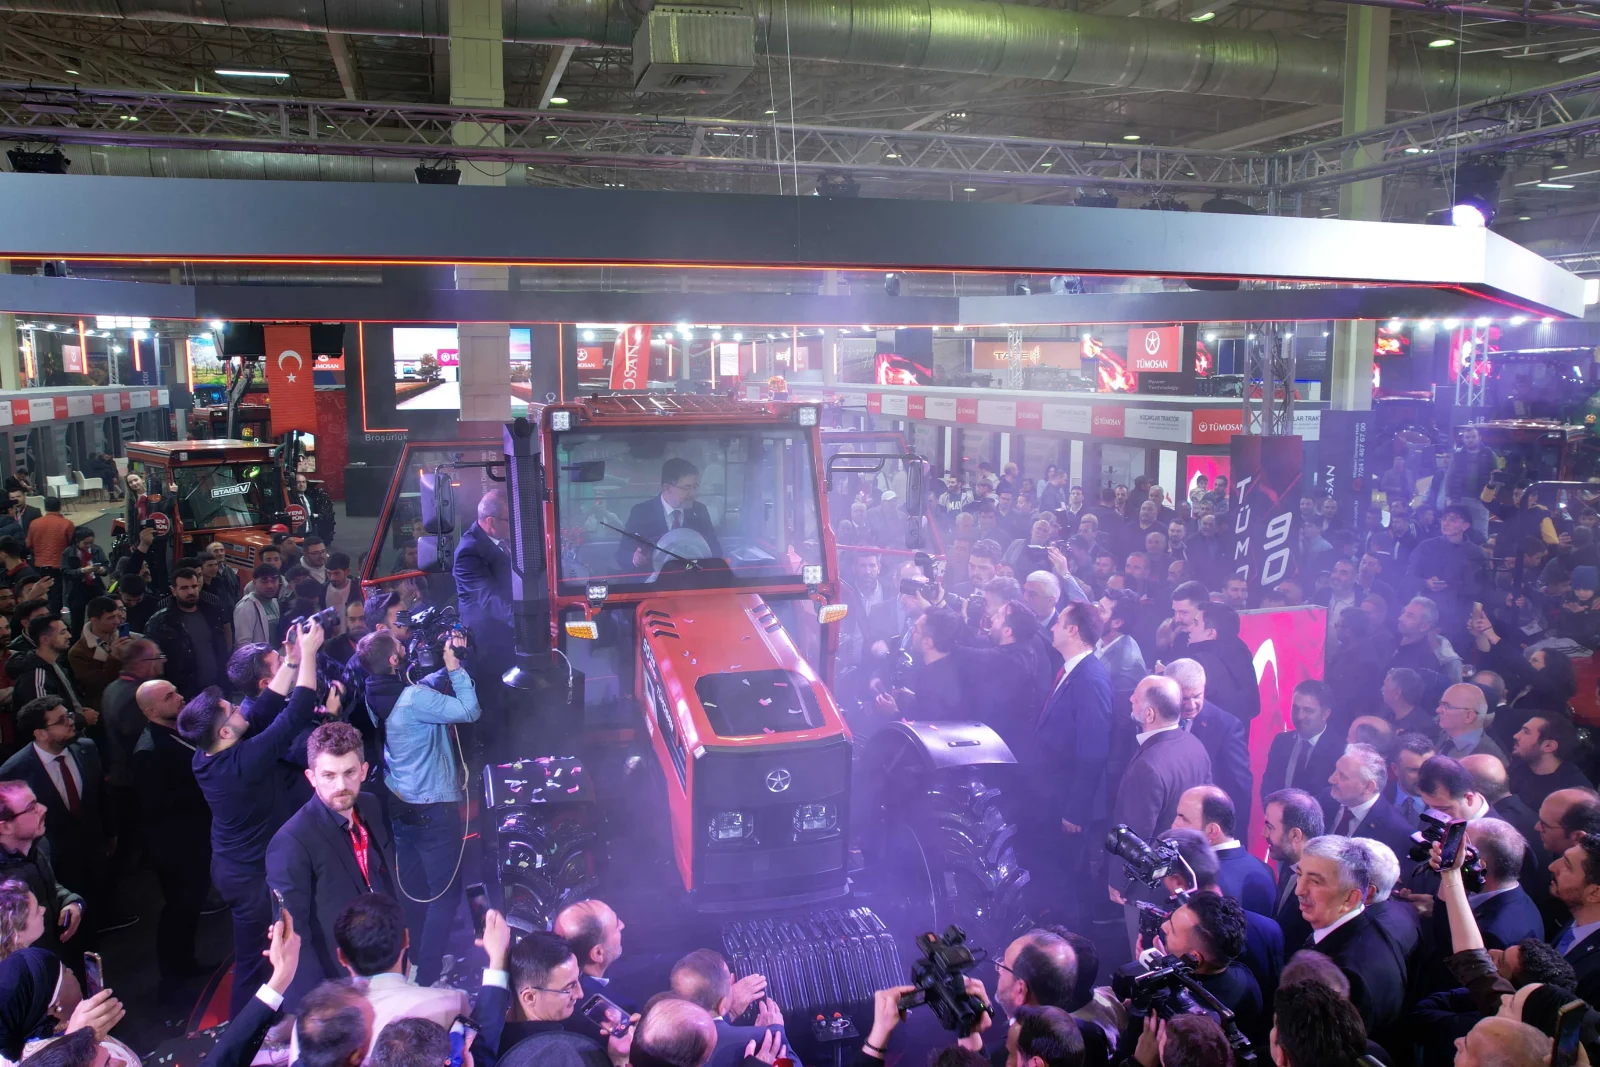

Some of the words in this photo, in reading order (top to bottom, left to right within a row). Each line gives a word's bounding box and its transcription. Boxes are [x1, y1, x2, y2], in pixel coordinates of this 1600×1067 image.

[993, 351, 1029, 361] TAE
[1136, 358, 1169, 369] TÜMOSAN
[1099, 417, 1122, 426] TÜMOSAN
[365, 434, 408, 442] Broşürlük
[1359, 433, 1366, 443] 67
[1325, 465, 1335, 499] SAN
[213, 487, 240, 496] STAGE
[240, 484, 248, 492] V
[1261, 511, 1293, 586] 90
